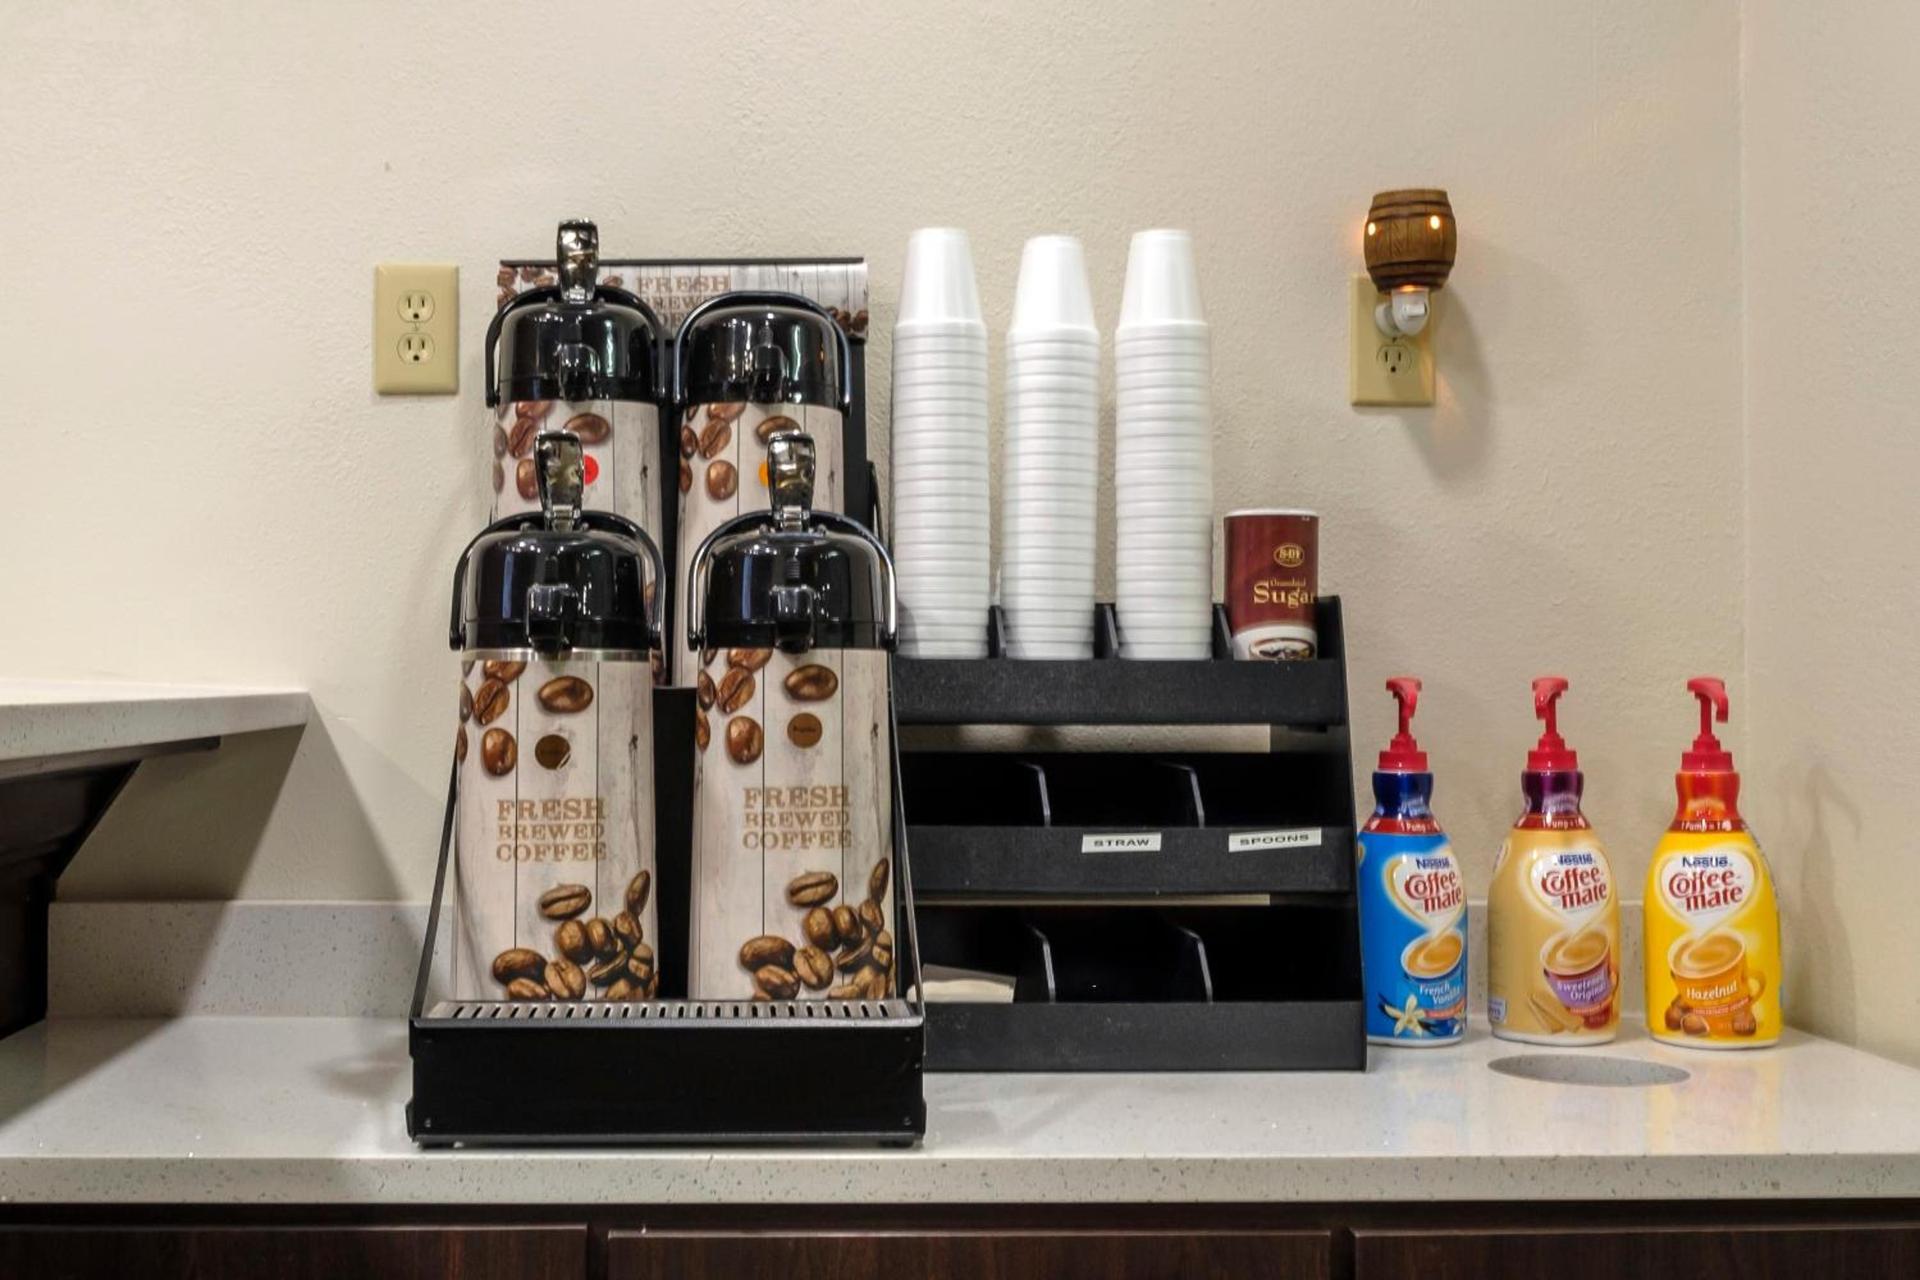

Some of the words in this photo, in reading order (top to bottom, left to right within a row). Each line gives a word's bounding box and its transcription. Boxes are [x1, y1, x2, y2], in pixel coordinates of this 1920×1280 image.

[637, 276, 731, 293] FRESH
[742, 785, 850, 809] FRESH
[497, 798, 607, 820] FRESH
[743, 810, 850, 828] BREWED
[498, 823, 606, 841] BREWED
[742, 830, 852, 850] COFFEE
[1093, 838, 1150, 847] STRAW
[1239, 834, 1310, 846] SPOONS
[496, 842, 608, 862] COFFEE
[1404, 870, 1458, 900] Coffee
[1541, 867, 1601, 896] Coffee
[1669, 869, 1735, 898] Coffee
[1561, 883, 1608, 910] mate
[1685, 885, 1744, 912] mate
[1686, 979, 1737, 1000] Hazelnut
